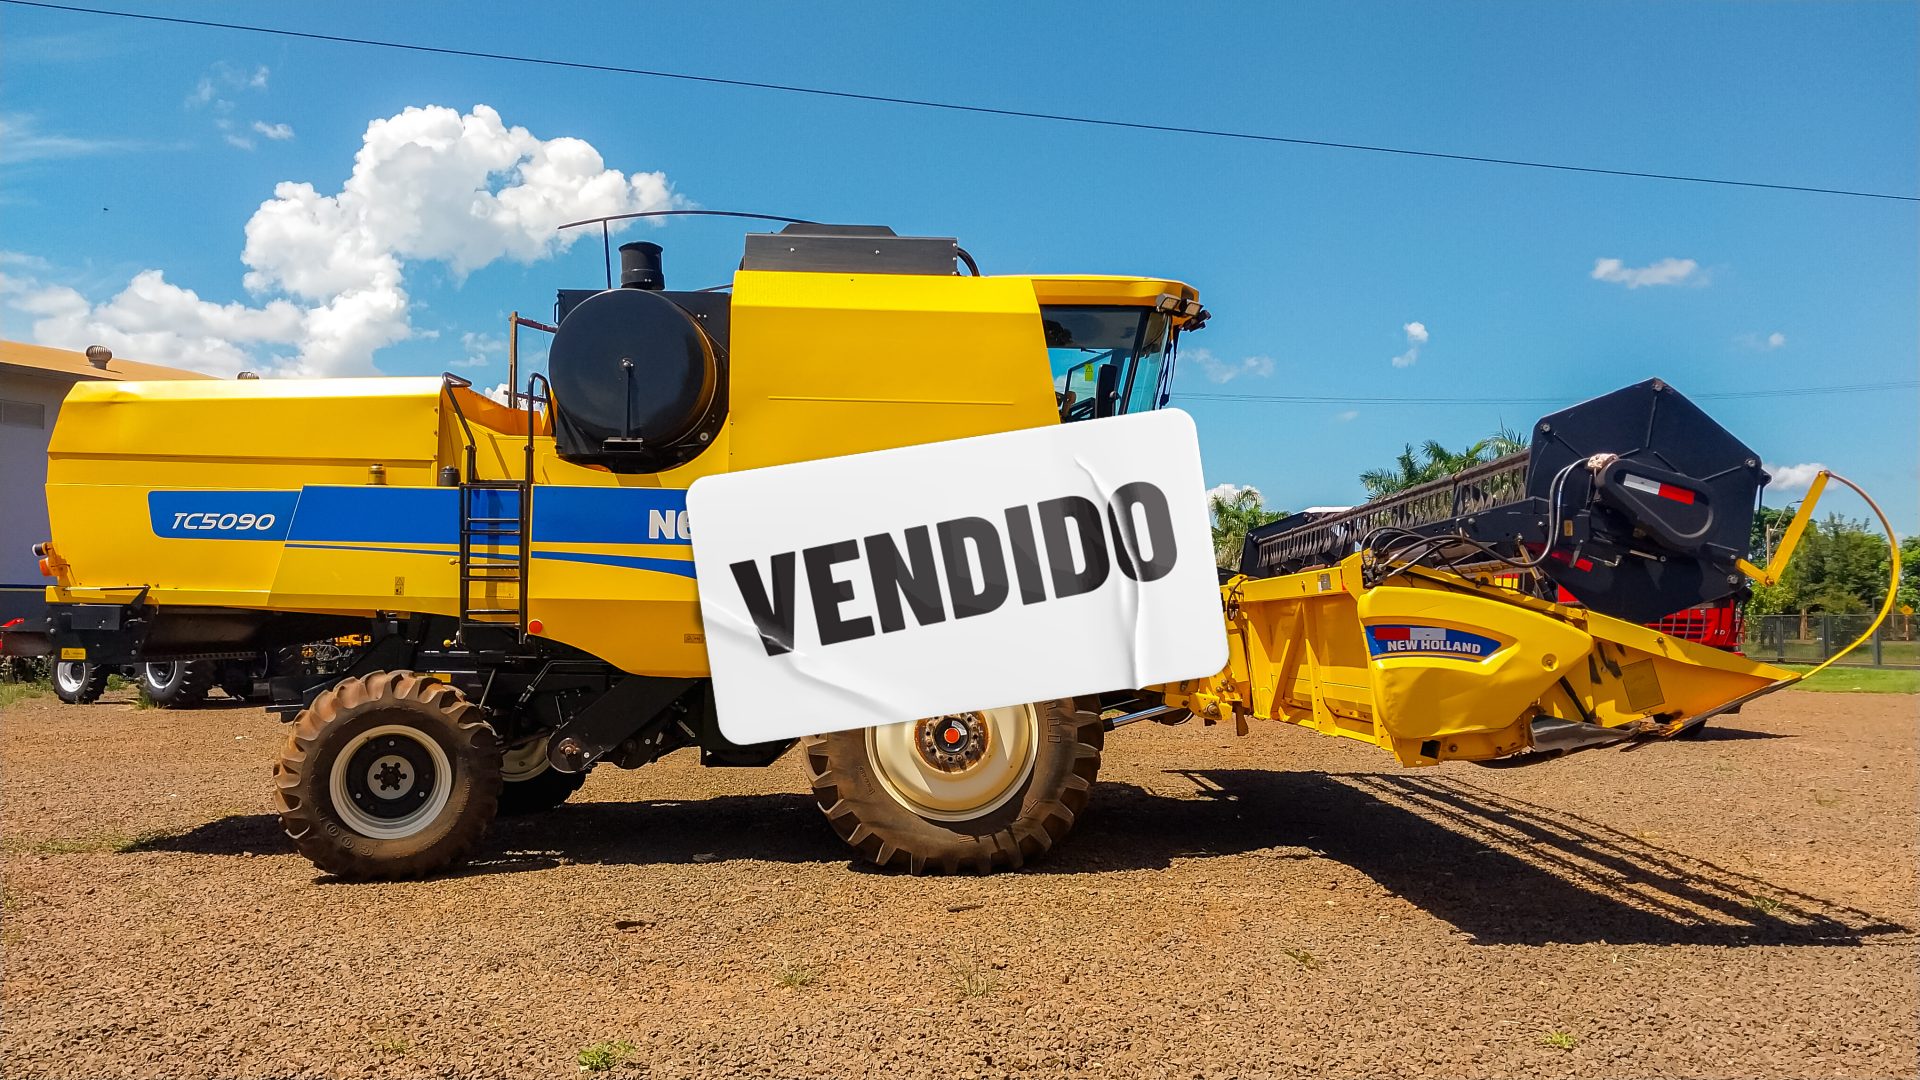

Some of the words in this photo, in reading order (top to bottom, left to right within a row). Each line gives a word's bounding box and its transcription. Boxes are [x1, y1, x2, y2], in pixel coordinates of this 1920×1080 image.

[172, 512, 276, 531] TC5090
[1387, 639, 1418, 652] NEW
[1421, 639, 1481, 654] HOLLAND
